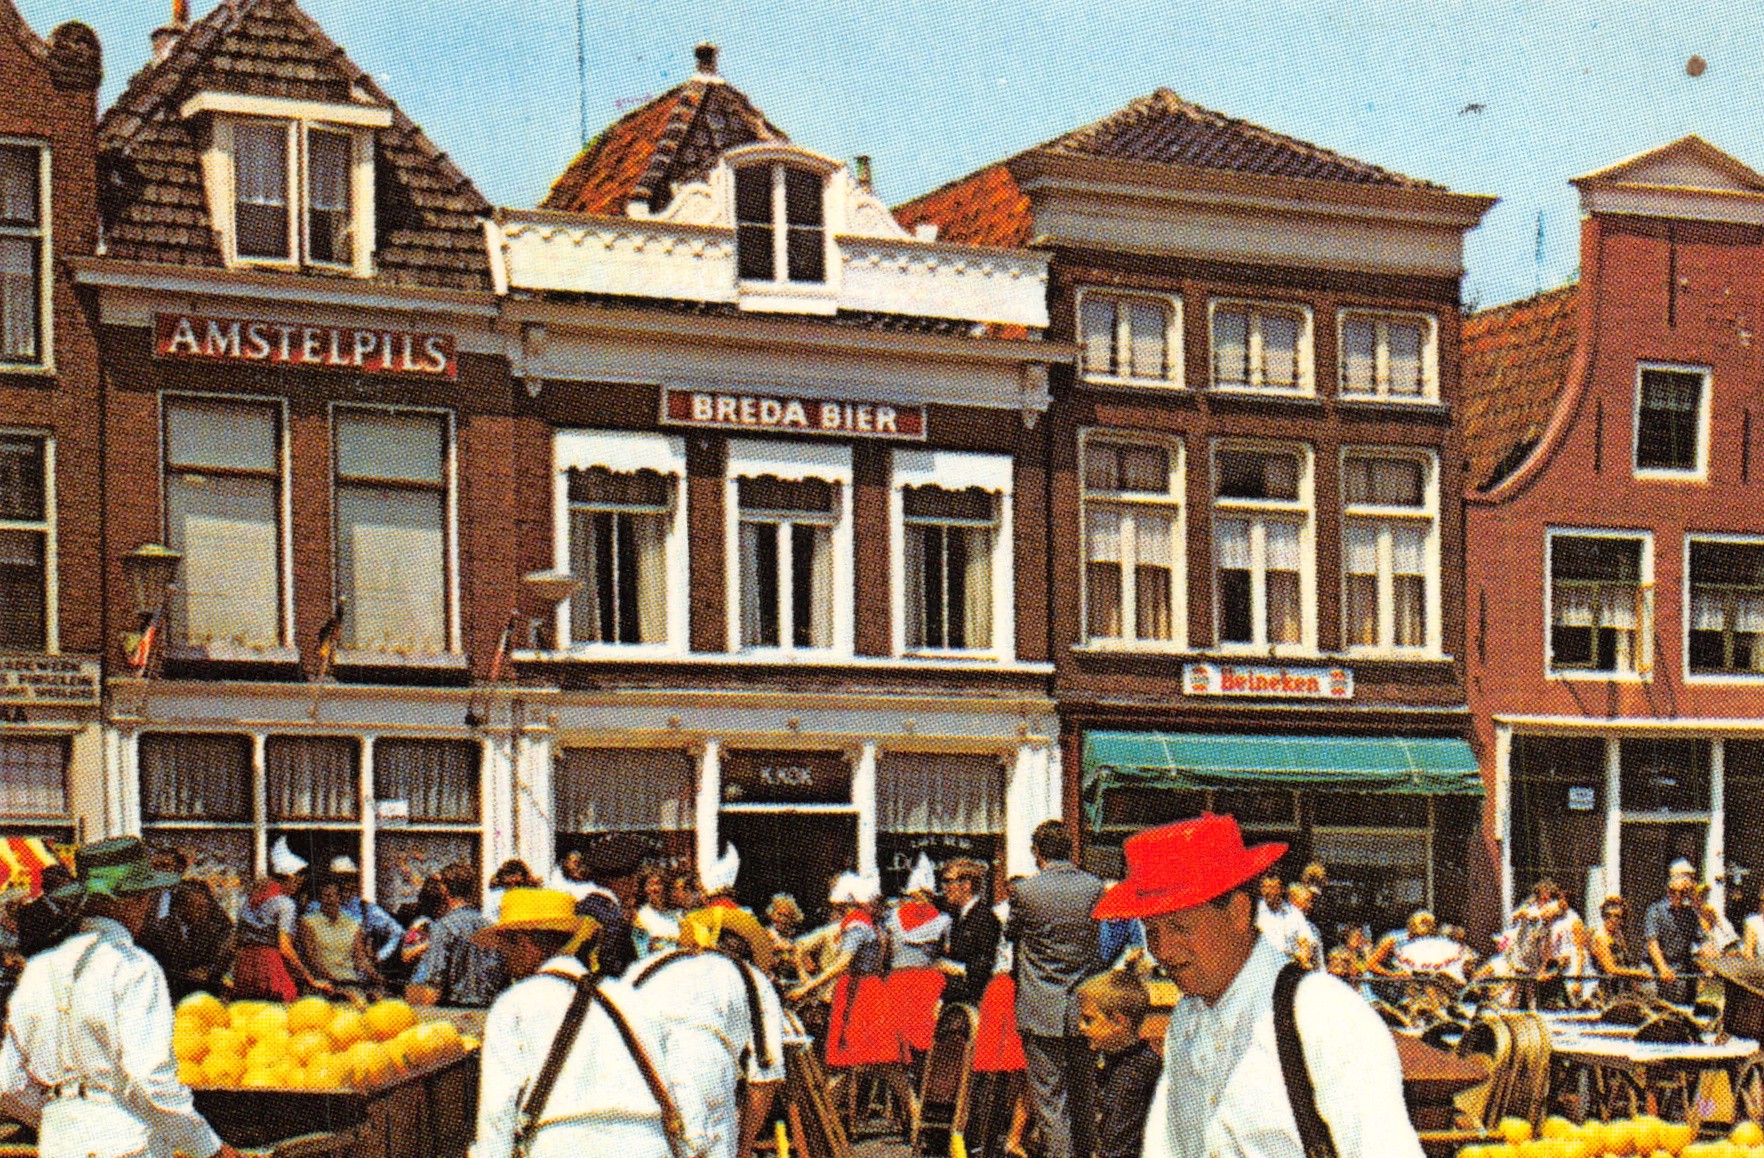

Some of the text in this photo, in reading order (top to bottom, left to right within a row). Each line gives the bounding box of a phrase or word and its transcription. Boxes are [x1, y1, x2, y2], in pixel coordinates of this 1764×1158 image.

[168, 317, 447, 373] AMSTELPILS
[692, 393, 897, 433] BREDA BIER
[1221, 666, 1320, 692] Heineken
